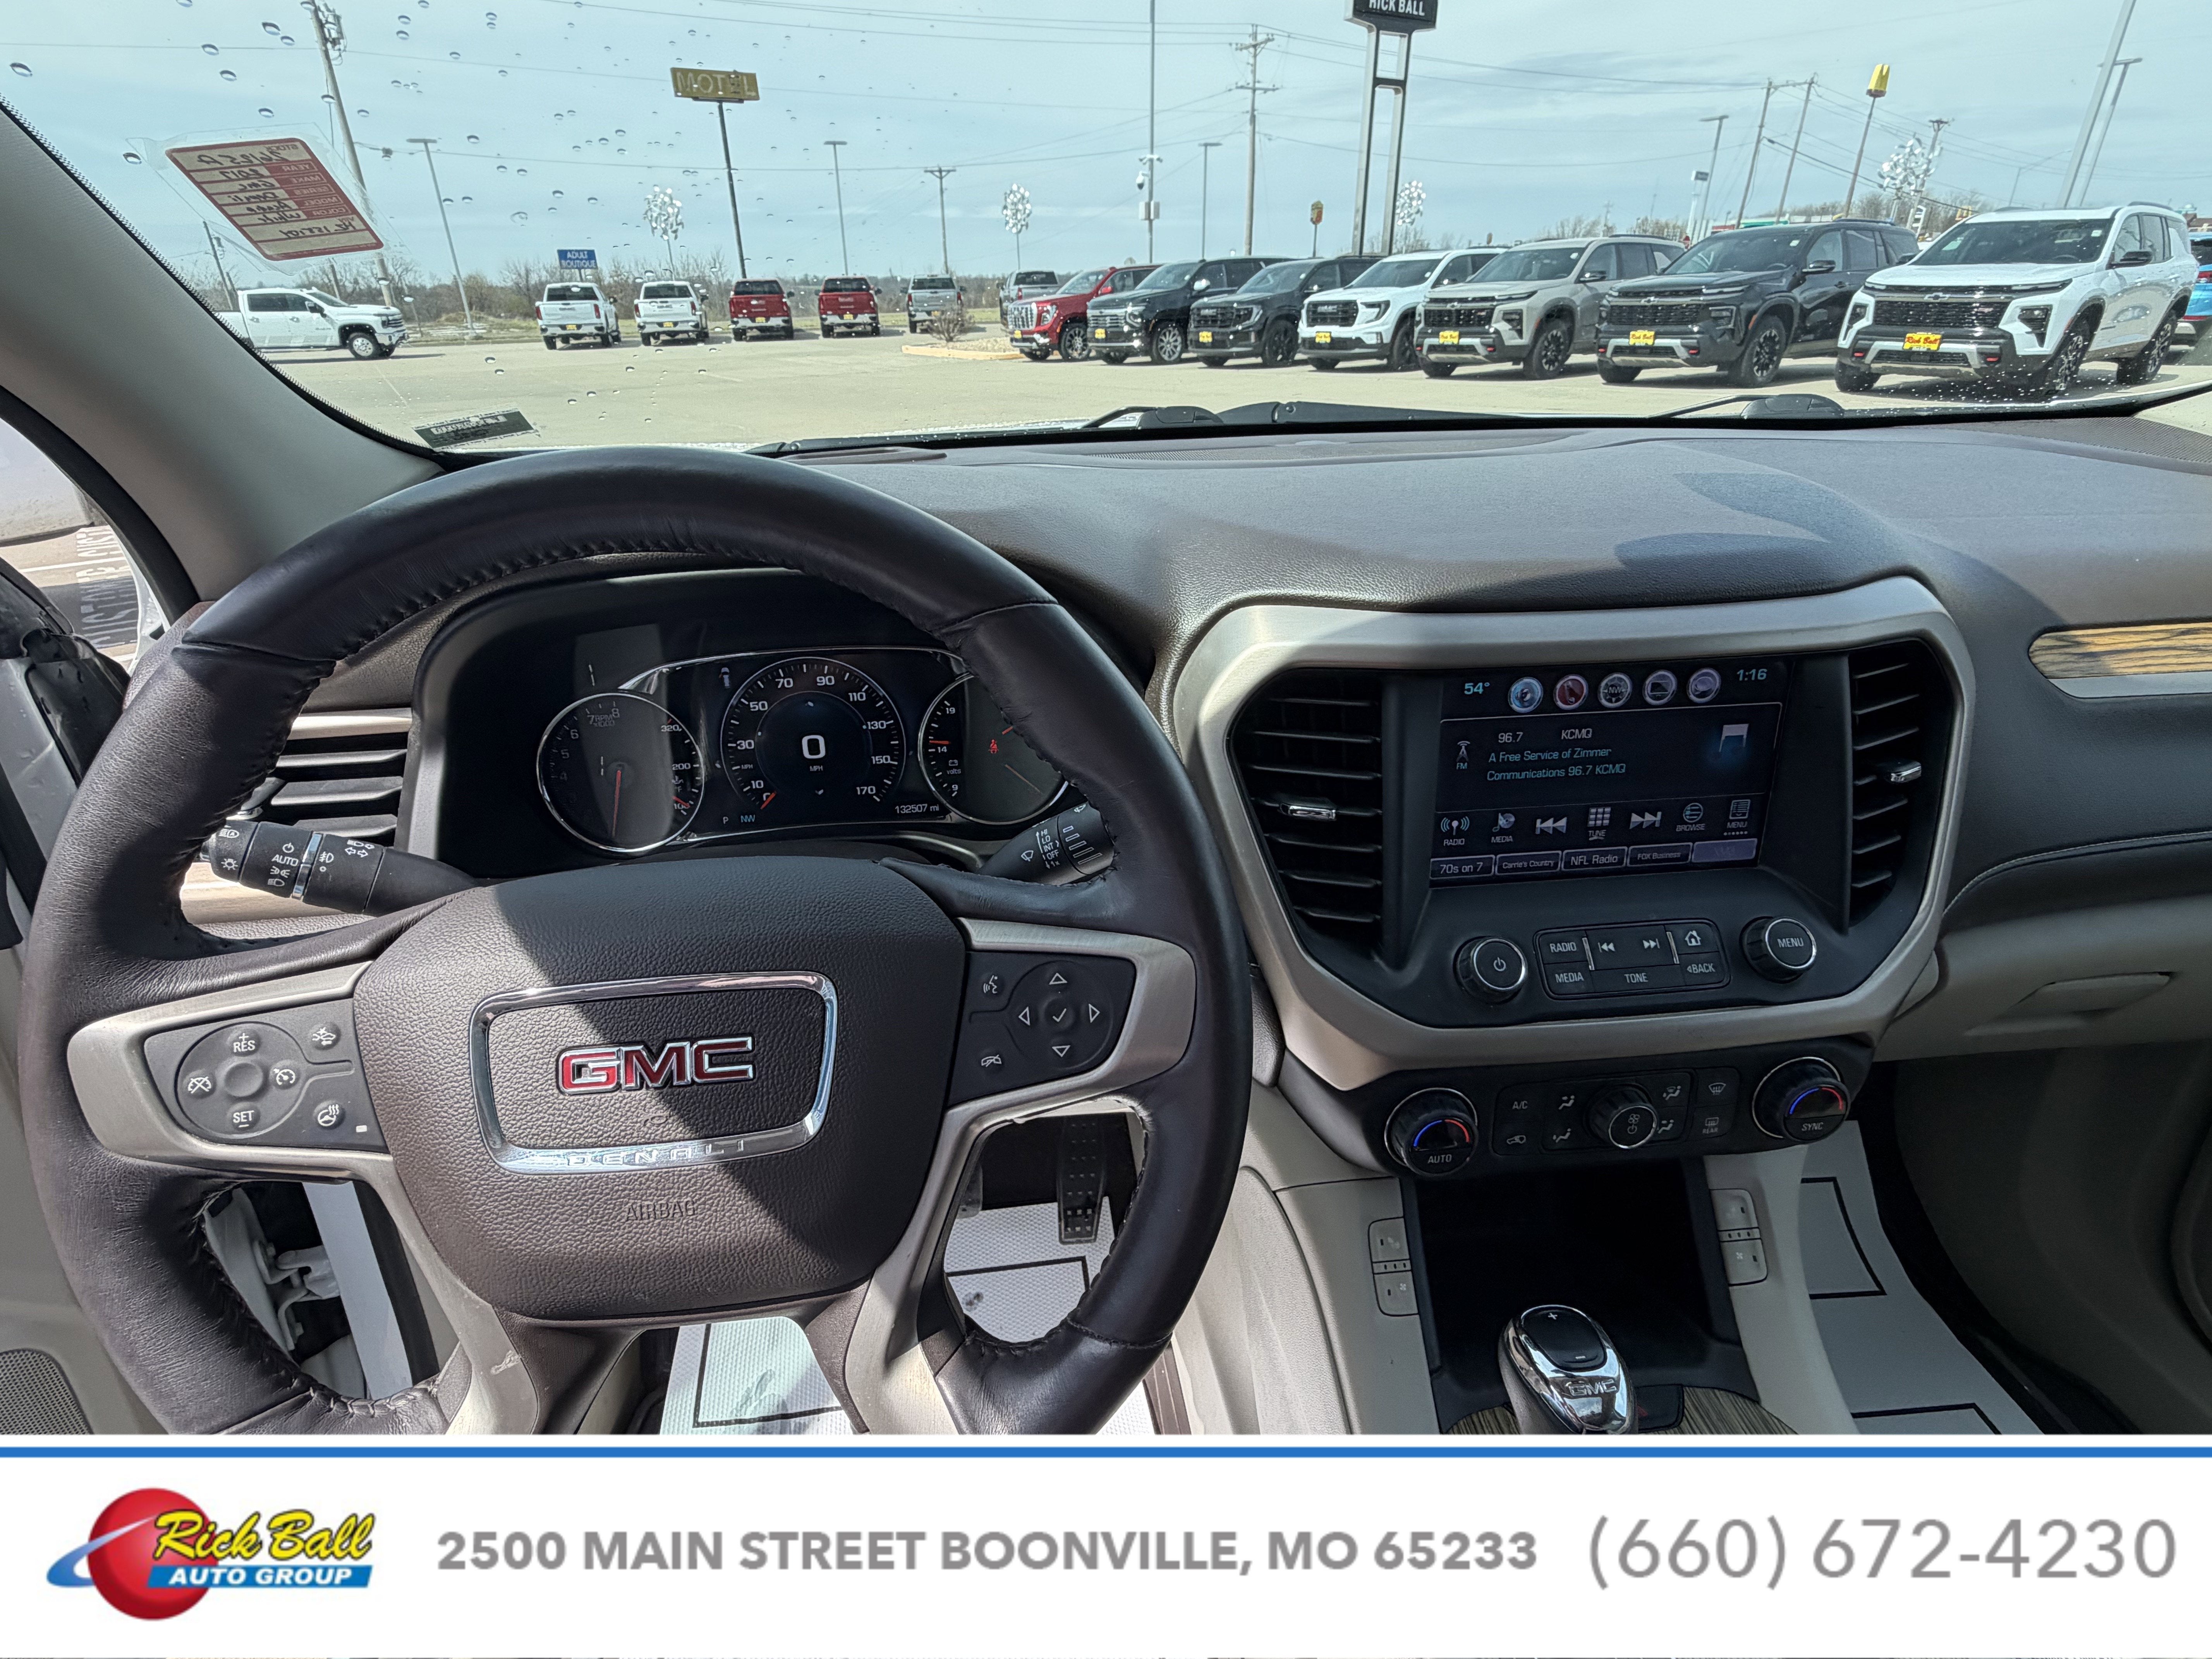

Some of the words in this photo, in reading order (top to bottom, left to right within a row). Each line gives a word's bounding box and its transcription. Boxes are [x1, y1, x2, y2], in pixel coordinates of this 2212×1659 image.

[1398, 0, 1425, 16] BALL
[1736, 668, 1767, 681] 1:16
[776, 678, 793, 689] 70
[816, 676, 835, 686] 90
[1464, 682, 1490, 695] 54°
[1608, 686, 1622, 694] NW
[848, 692, 866, 701] 110
[750, 701, 768, 711] 50
[867, 721, 886, 729] 130
[570, 730, 579, 738] 6
[1498, 732, 1523, 743] 96.7
[1561, 728, 1593, 740] KCMQ
[737, 740, 754, 749] 30
[802, 735, 826, 759] 0
[871, 756, 890, 764] 150
[1488, 753, 1496, 763] A
[1499, 751, 1521, 763] Free
[1523, 749, 1559, 761] Service
[1561, 749, 1571, 759] of
[1573, 747, 1611, 758] Zimmer
[1487, 767, 1566, 781] Communications
[1568, 765, 1593, 777] 96.7
[1595, 764, 1626, 775] KCMQ
[751, 780, 764, 789] 10
[856, 786, 876, 795] 170
[895, 805, 927, 813] 132507
[930, 804, 939, 812] mi
[1676, 823, 1705, 832] BROWSE
[1042, 835, 1050, 844] LO
[1443, 838, 1465, 847] RADIO
[1491, 835, 1513, 843] MEDIA
[1043, 842, 1054, 852] INT
[271, 854, 299, 867] AUTO
[1047, 850, 1059, 860] OFF
[1571, 856, 1589, 865] NFL
[1592, 854, 1618, 864] Radio
[1440, 864, 1459, 874] 70s
[1477, 862, 1483, 871] 7
[1549, 942, 1577, 953] RADIO
[1777, 937, 1804, 948] MENU
[1692, 963, 1716, 974] BACK
[1555, 972, 1584, 983] MEDIA
[1624, 972, 1648, 983] TONE
[233, 1040, 255, 1053] RES
[558, 1035, 754, 1095] GMC
[1512, 1099, 1528, 1111] A/C
[233, 1110, 254, 1123] SET
[1801, 1121, 1824, 1132] SYNC
[568, 1139, 745, 1167] DENALI
[1428, 1154, 1452, 1164] AUTO
[625, 1199, 697, 1223] AIRBAG
[1565, 1379, 1618, 1396] GMC
